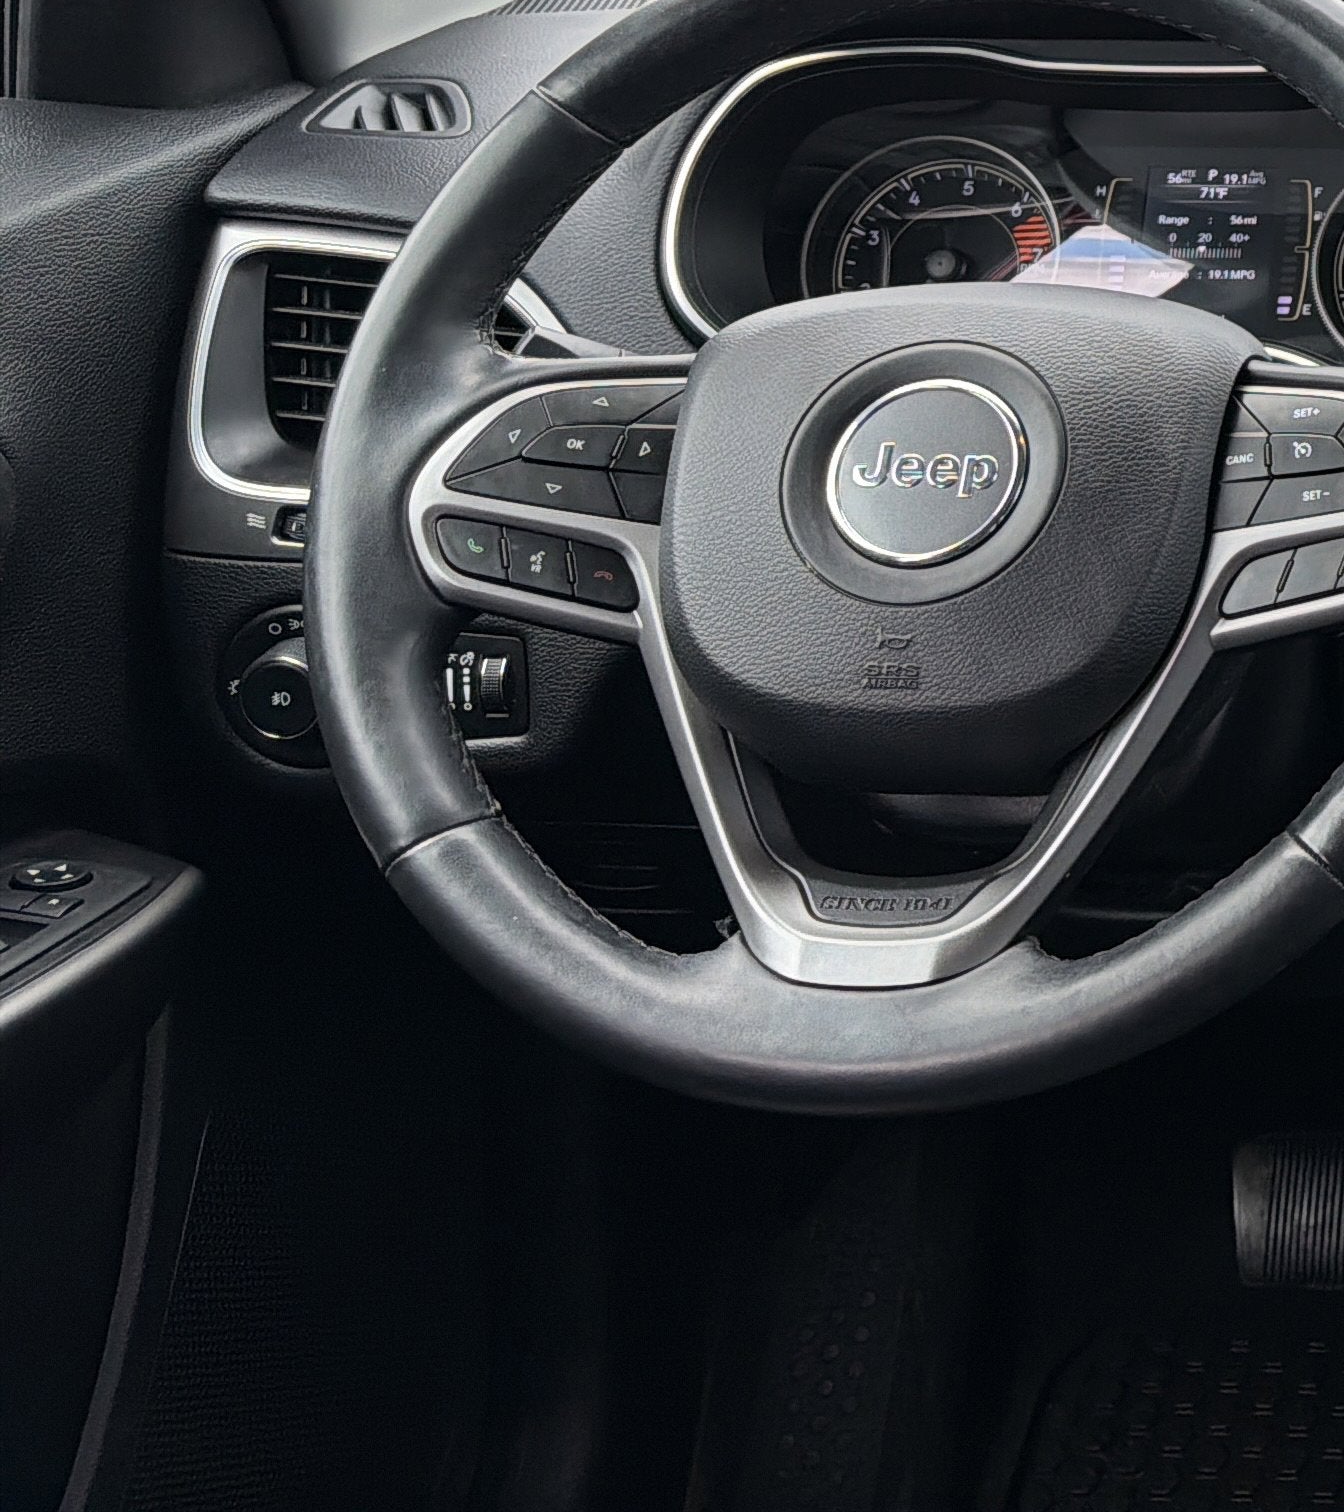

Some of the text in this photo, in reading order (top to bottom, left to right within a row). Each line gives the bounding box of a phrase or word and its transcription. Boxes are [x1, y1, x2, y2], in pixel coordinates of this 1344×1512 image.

[1207, 168, 1219, 182] P
[962, 180, 975, 196] 5
[1313, 187, 1324, 199] F
[908, 191, 921, 206] 4
[1011, 205, 1023, 218] 6
[1157, 214, 1190, 227] Range
[867, 230, 880, 246] 3
[1197, 232, 1213, 243] 20
[1301, 304, 1312, 316] E
[566, 438, 586, 451] OK
[1225, 453, 1255, 466] CANC
[852, 440, 999, 499] Jeep
[863, 662, 922, 678] SRS
[863, 678, 920, 689] AIRBAG
